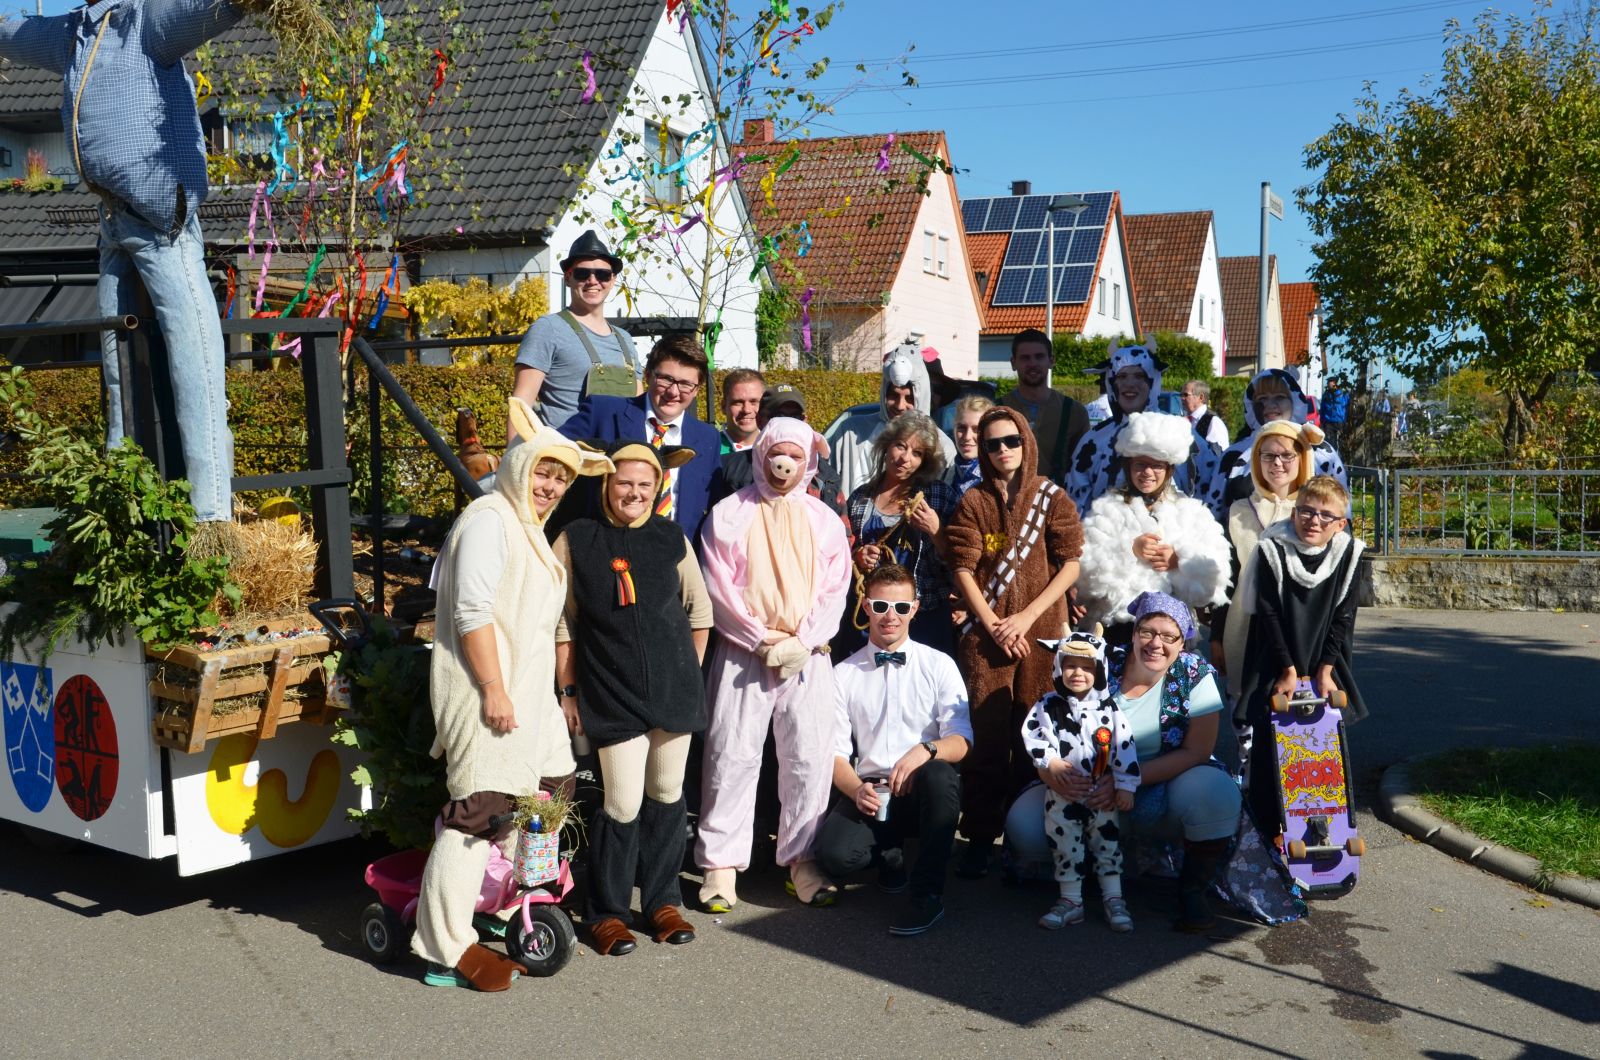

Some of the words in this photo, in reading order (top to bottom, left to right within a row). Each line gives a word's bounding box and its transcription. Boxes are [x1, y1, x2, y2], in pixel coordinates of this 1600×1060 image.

[777, 384, 792, 392] CAT
[1284, 759, 1343, 791] SHOCK
[1287, 805, 1347, 817] TREATMENT
